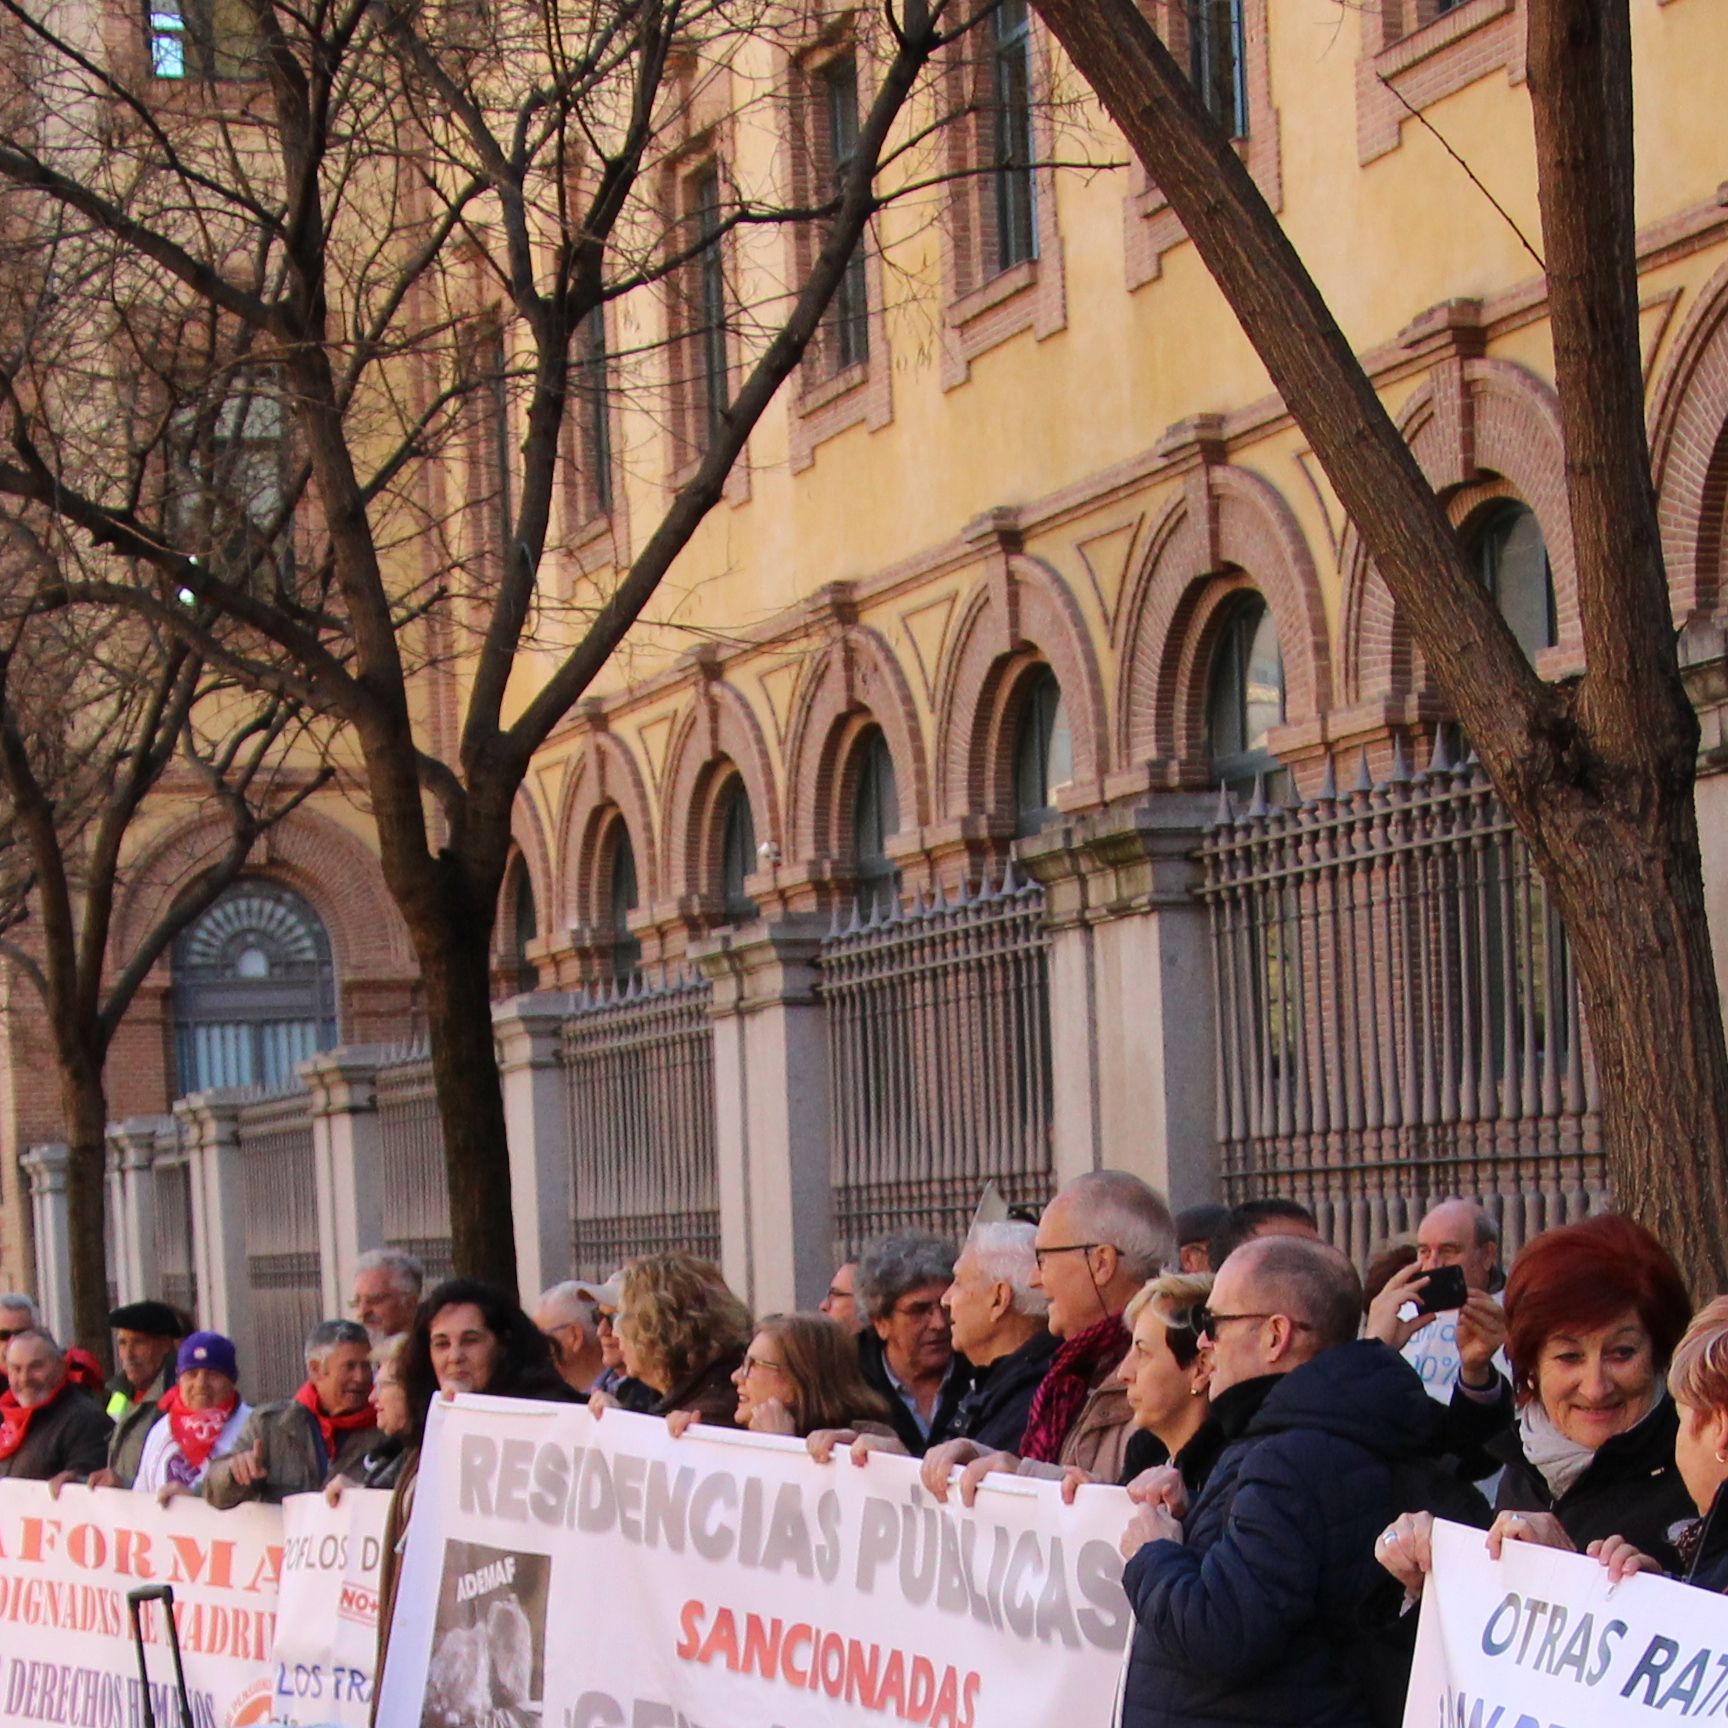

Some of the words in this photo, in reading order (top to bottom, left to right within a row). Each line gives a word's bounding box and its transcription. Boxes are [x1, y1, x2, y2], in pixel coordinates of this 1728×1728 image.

[458, 1433, 842, 1584] RESIDENCIAS
[856, 1484, 1130, 1653] PÚBLICAS
[457, 1556, 515, 1602] ADEMAF
[170, 1598, 277, 1664] ADRI
[1481, 1592, 1628, 1687] OTRAS
[277, 1662, 321, 1699] LOS
